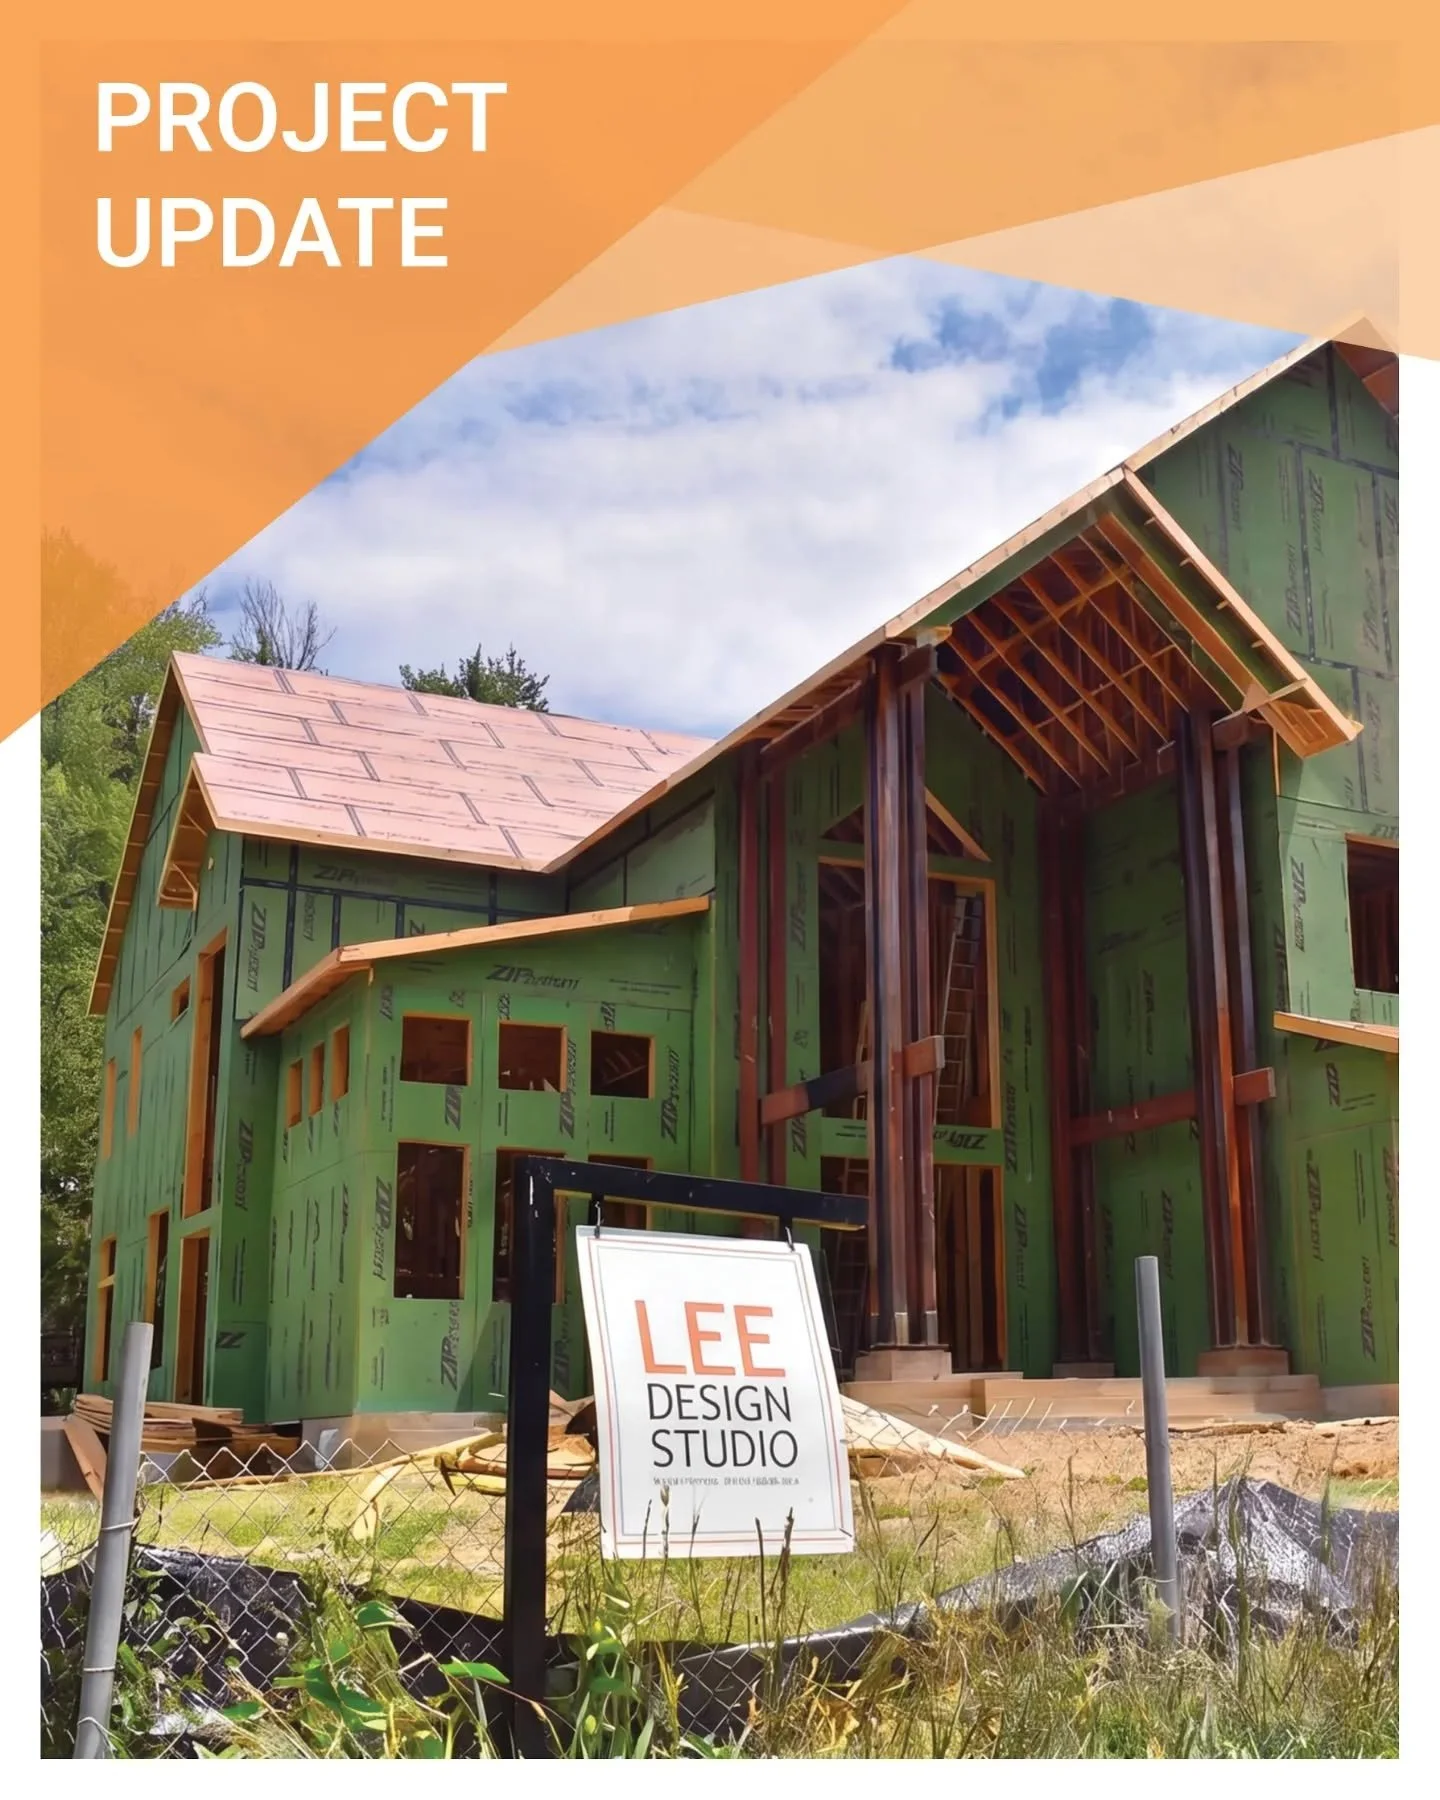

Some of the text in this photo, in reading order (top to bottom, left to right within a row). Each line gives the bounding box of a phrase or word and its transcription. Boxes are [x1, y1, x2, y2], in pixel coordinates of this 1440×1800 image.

[634, 1300, 786, 1377] LEE
[647, 1383, 792, 1422] DESIGN
[652, 1429, 798, 1468] STUDIO
